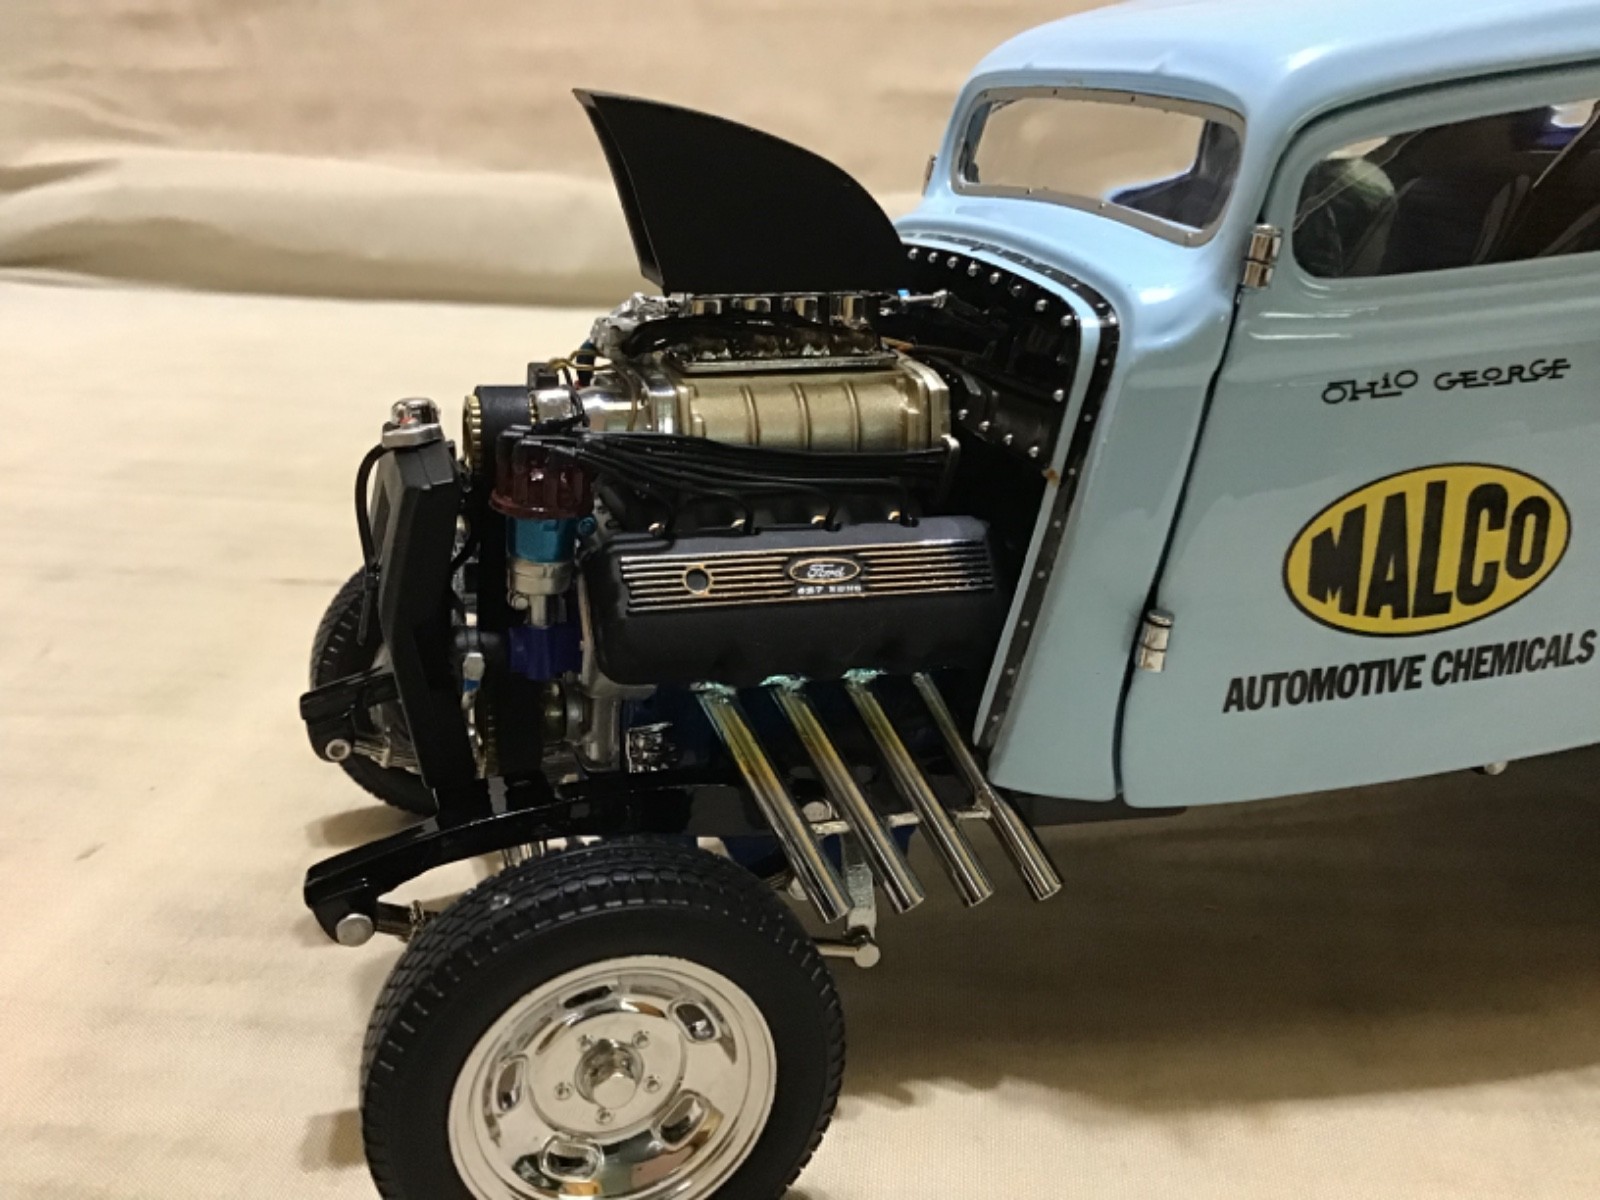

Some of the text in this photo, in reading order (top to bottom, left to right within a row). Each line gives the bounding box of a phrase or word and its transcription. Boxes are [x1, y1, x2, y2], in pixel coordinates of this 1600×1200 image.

[1434, 358, 1571, 391] GEORGE
[807, 563, 846, 579] Ford
[1307, 480, 1552, 620] MALCO
[1222, 629, 1597, 713] AUTOMOTIVE CHEMICALS
